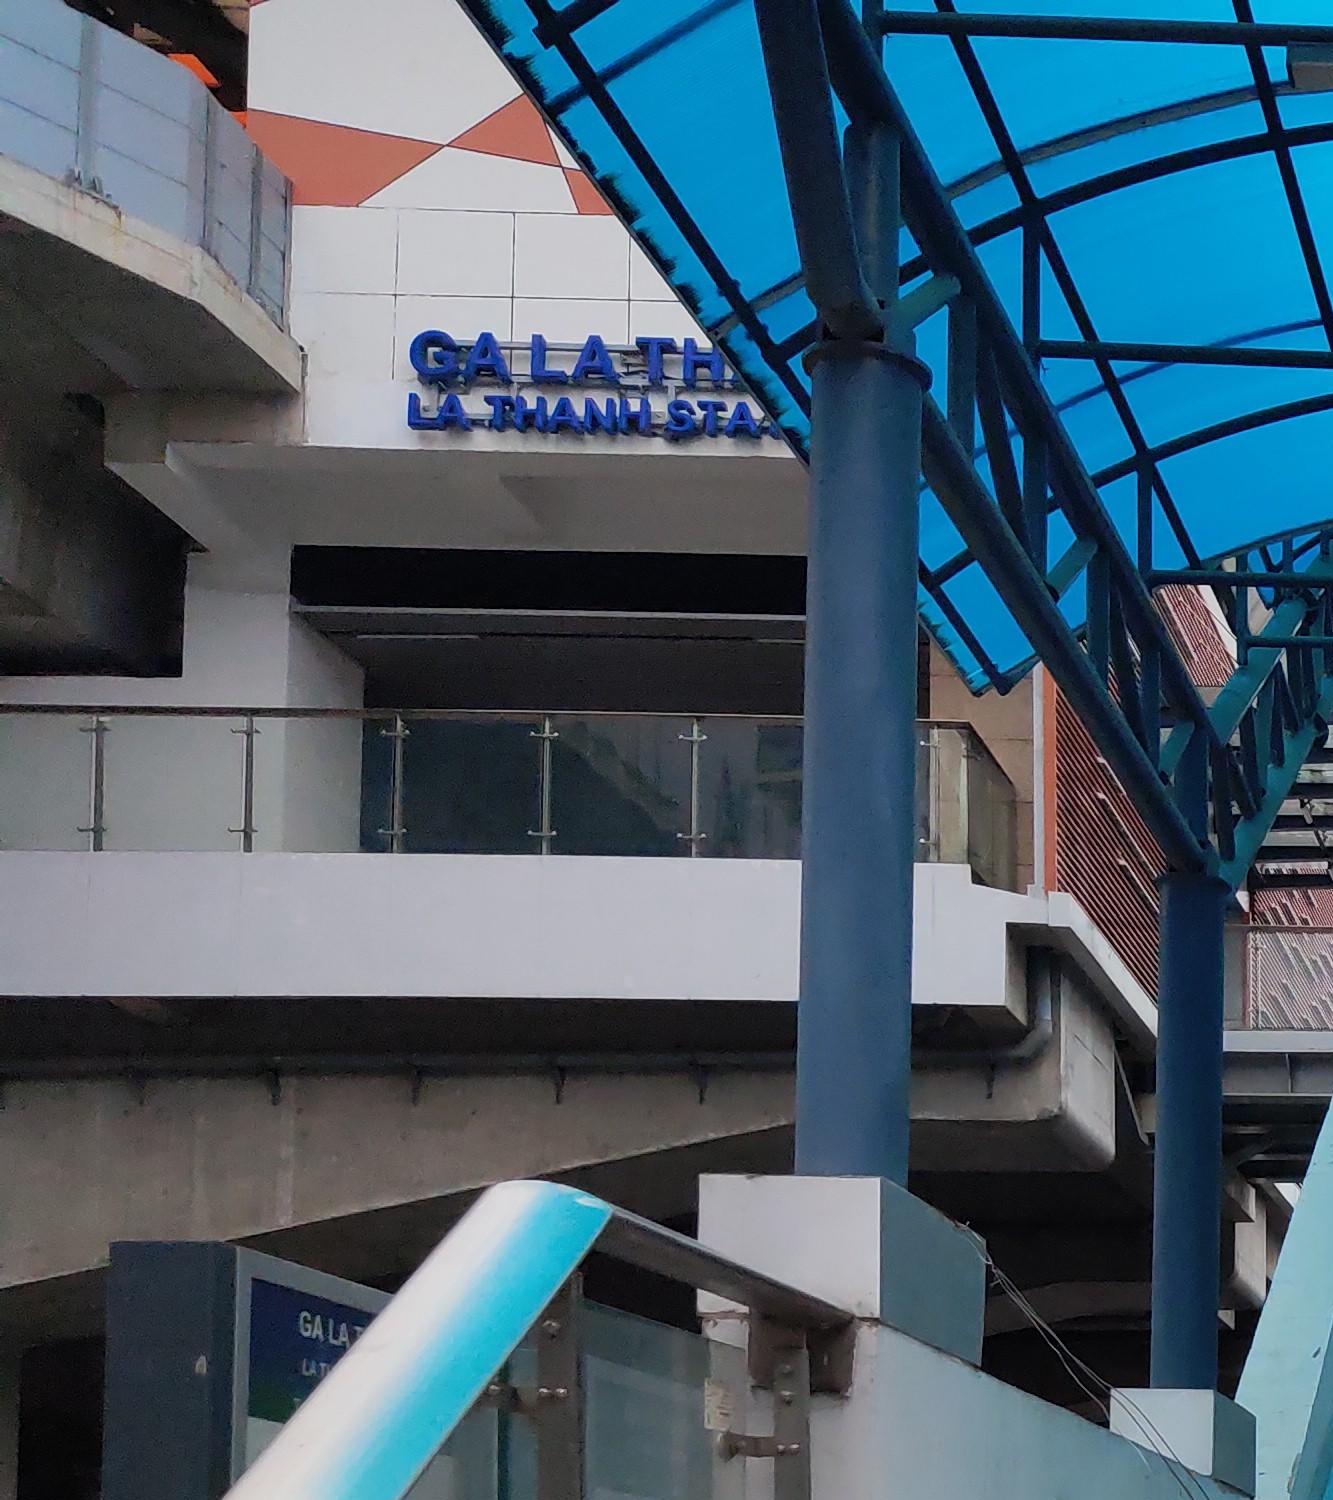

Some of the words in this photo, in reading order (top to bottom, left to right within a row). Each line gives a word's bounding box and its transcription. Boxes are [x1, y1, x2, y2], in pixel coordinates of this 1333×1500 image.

[409, 329, 513, 386] GA
[530, 333, 625, 386] LA
[635, 335, 736, 390] TH
[407, 391, 471, 431] LA
[484, 394, 652, 435] THANH
[298, 1309, 325, 1345] GA
[326, 1317, 350, 1349] LA
